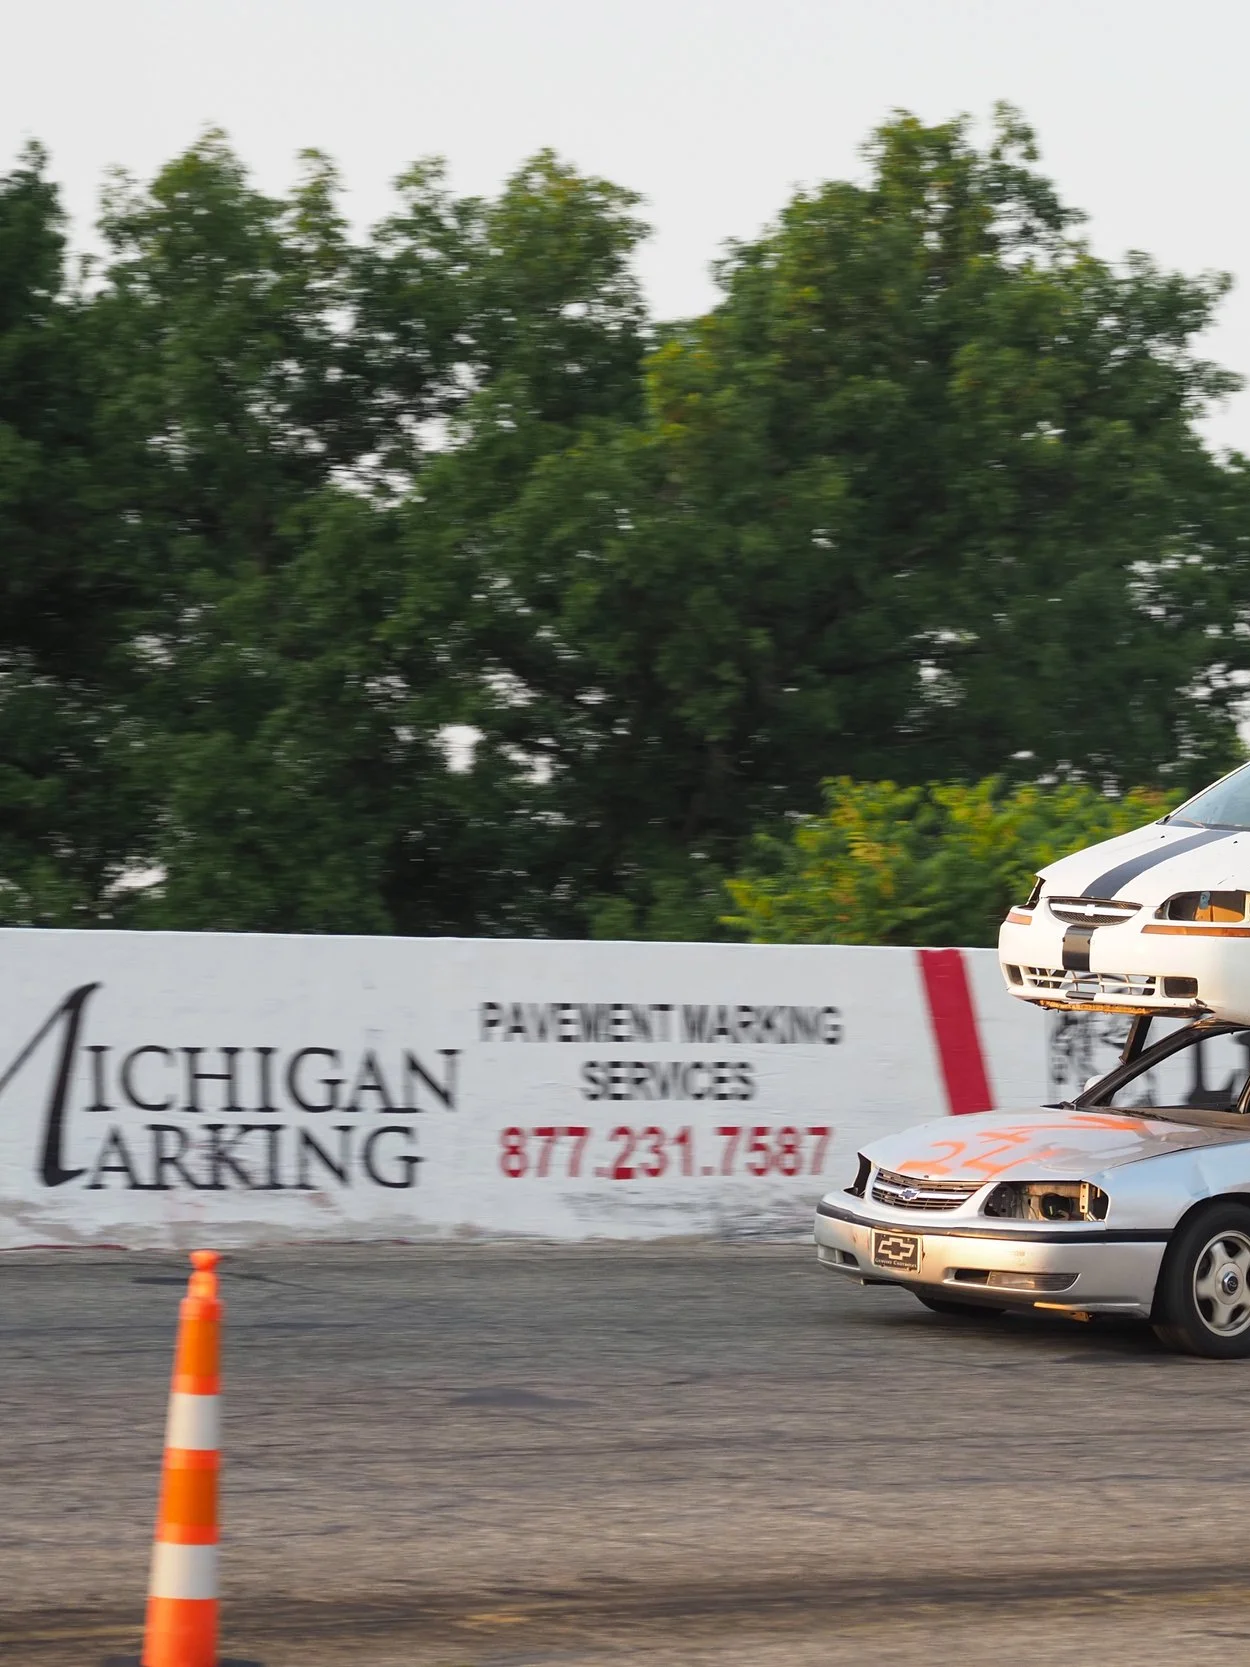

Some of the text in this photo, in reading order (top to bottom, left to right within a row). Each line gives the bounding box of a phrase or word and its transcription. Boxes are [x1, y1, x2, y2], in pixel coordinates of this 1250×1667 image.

[481, 1002, 844, 1045] PAVEMENT MARKING
[580, 1060, 756, 1101] SERVICES
[499, 1126, 834, 1179] 877.231.7587
